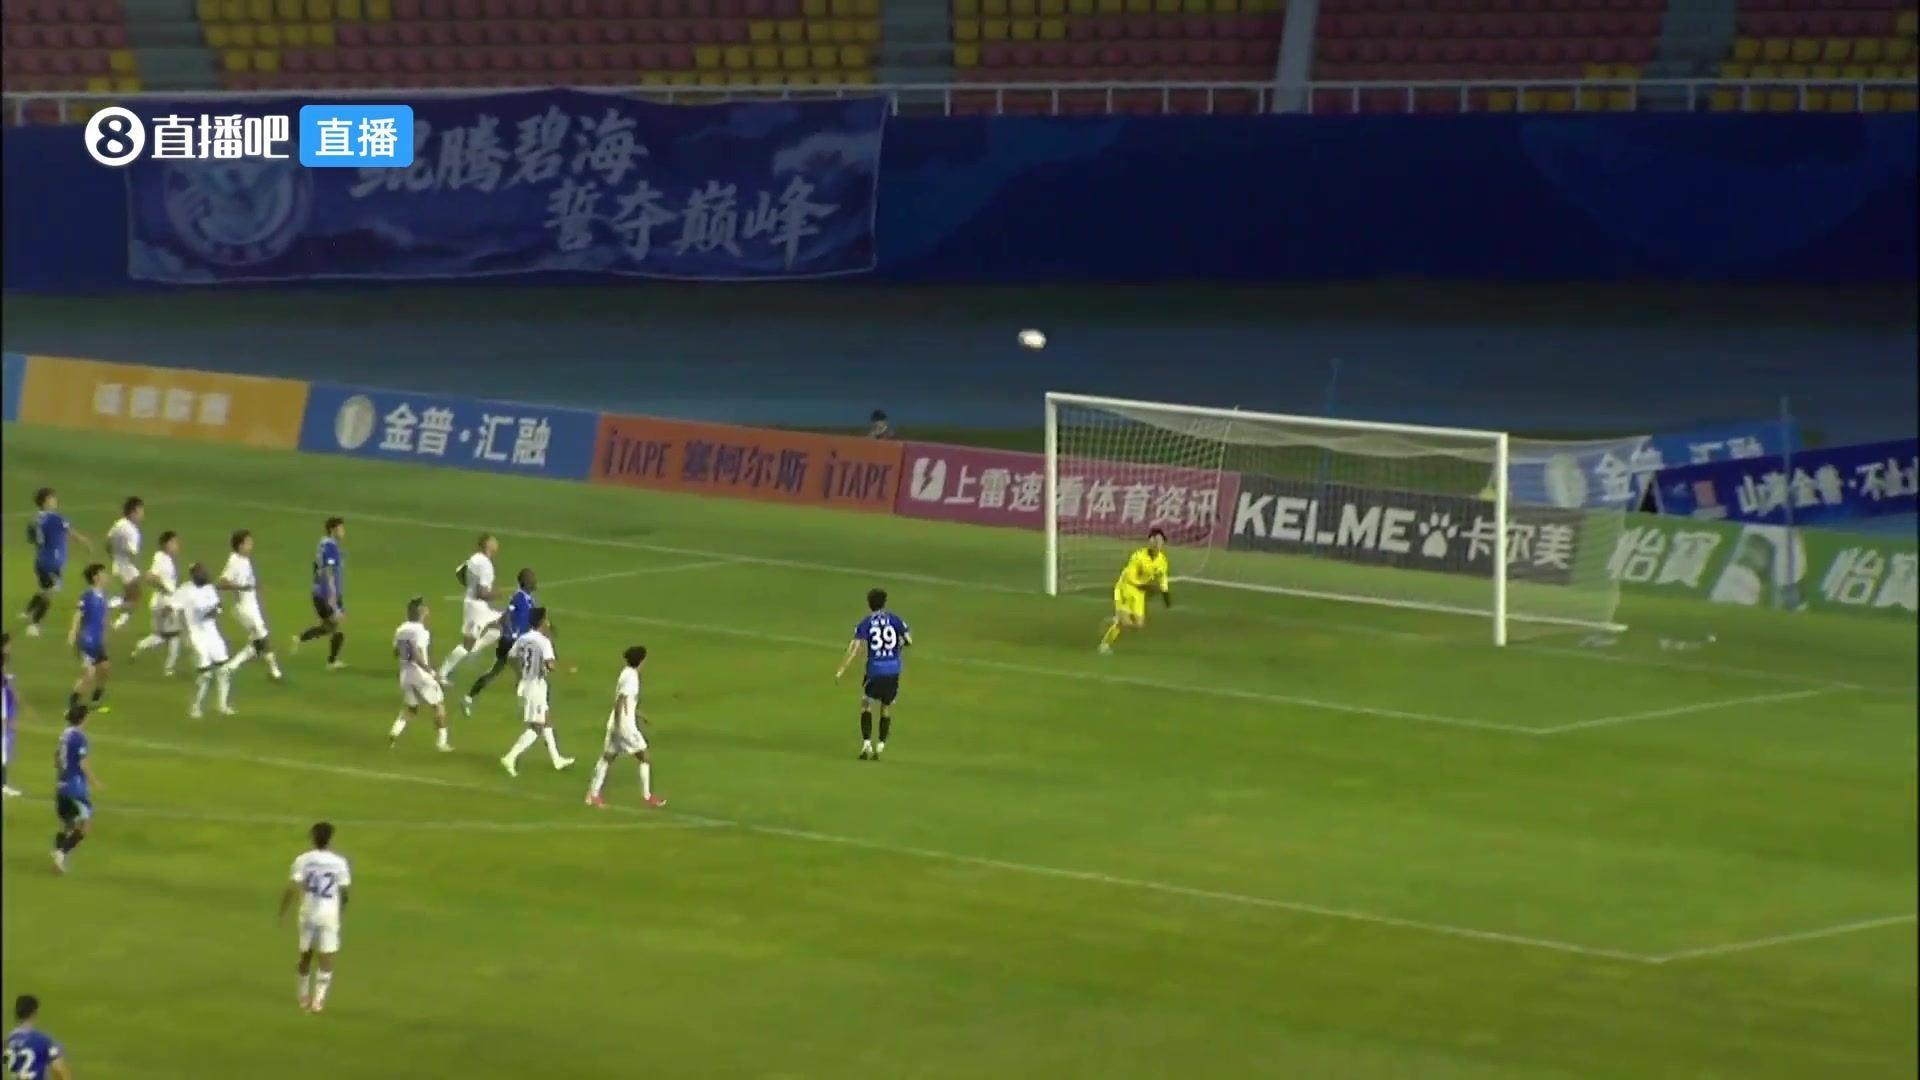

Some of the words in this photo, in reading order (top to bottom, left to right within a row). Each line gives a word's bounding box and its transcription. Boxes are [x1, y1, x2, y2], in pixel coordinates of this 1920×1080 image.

[543, 176, 839, 270] 誓夺巅峰
[1233, 491, 1416, 554] KELME
[1459, 515, 1575, 570] 卡尔美
[869, 625, 897, 650] 39
[303, 870, 336, 898] 42
